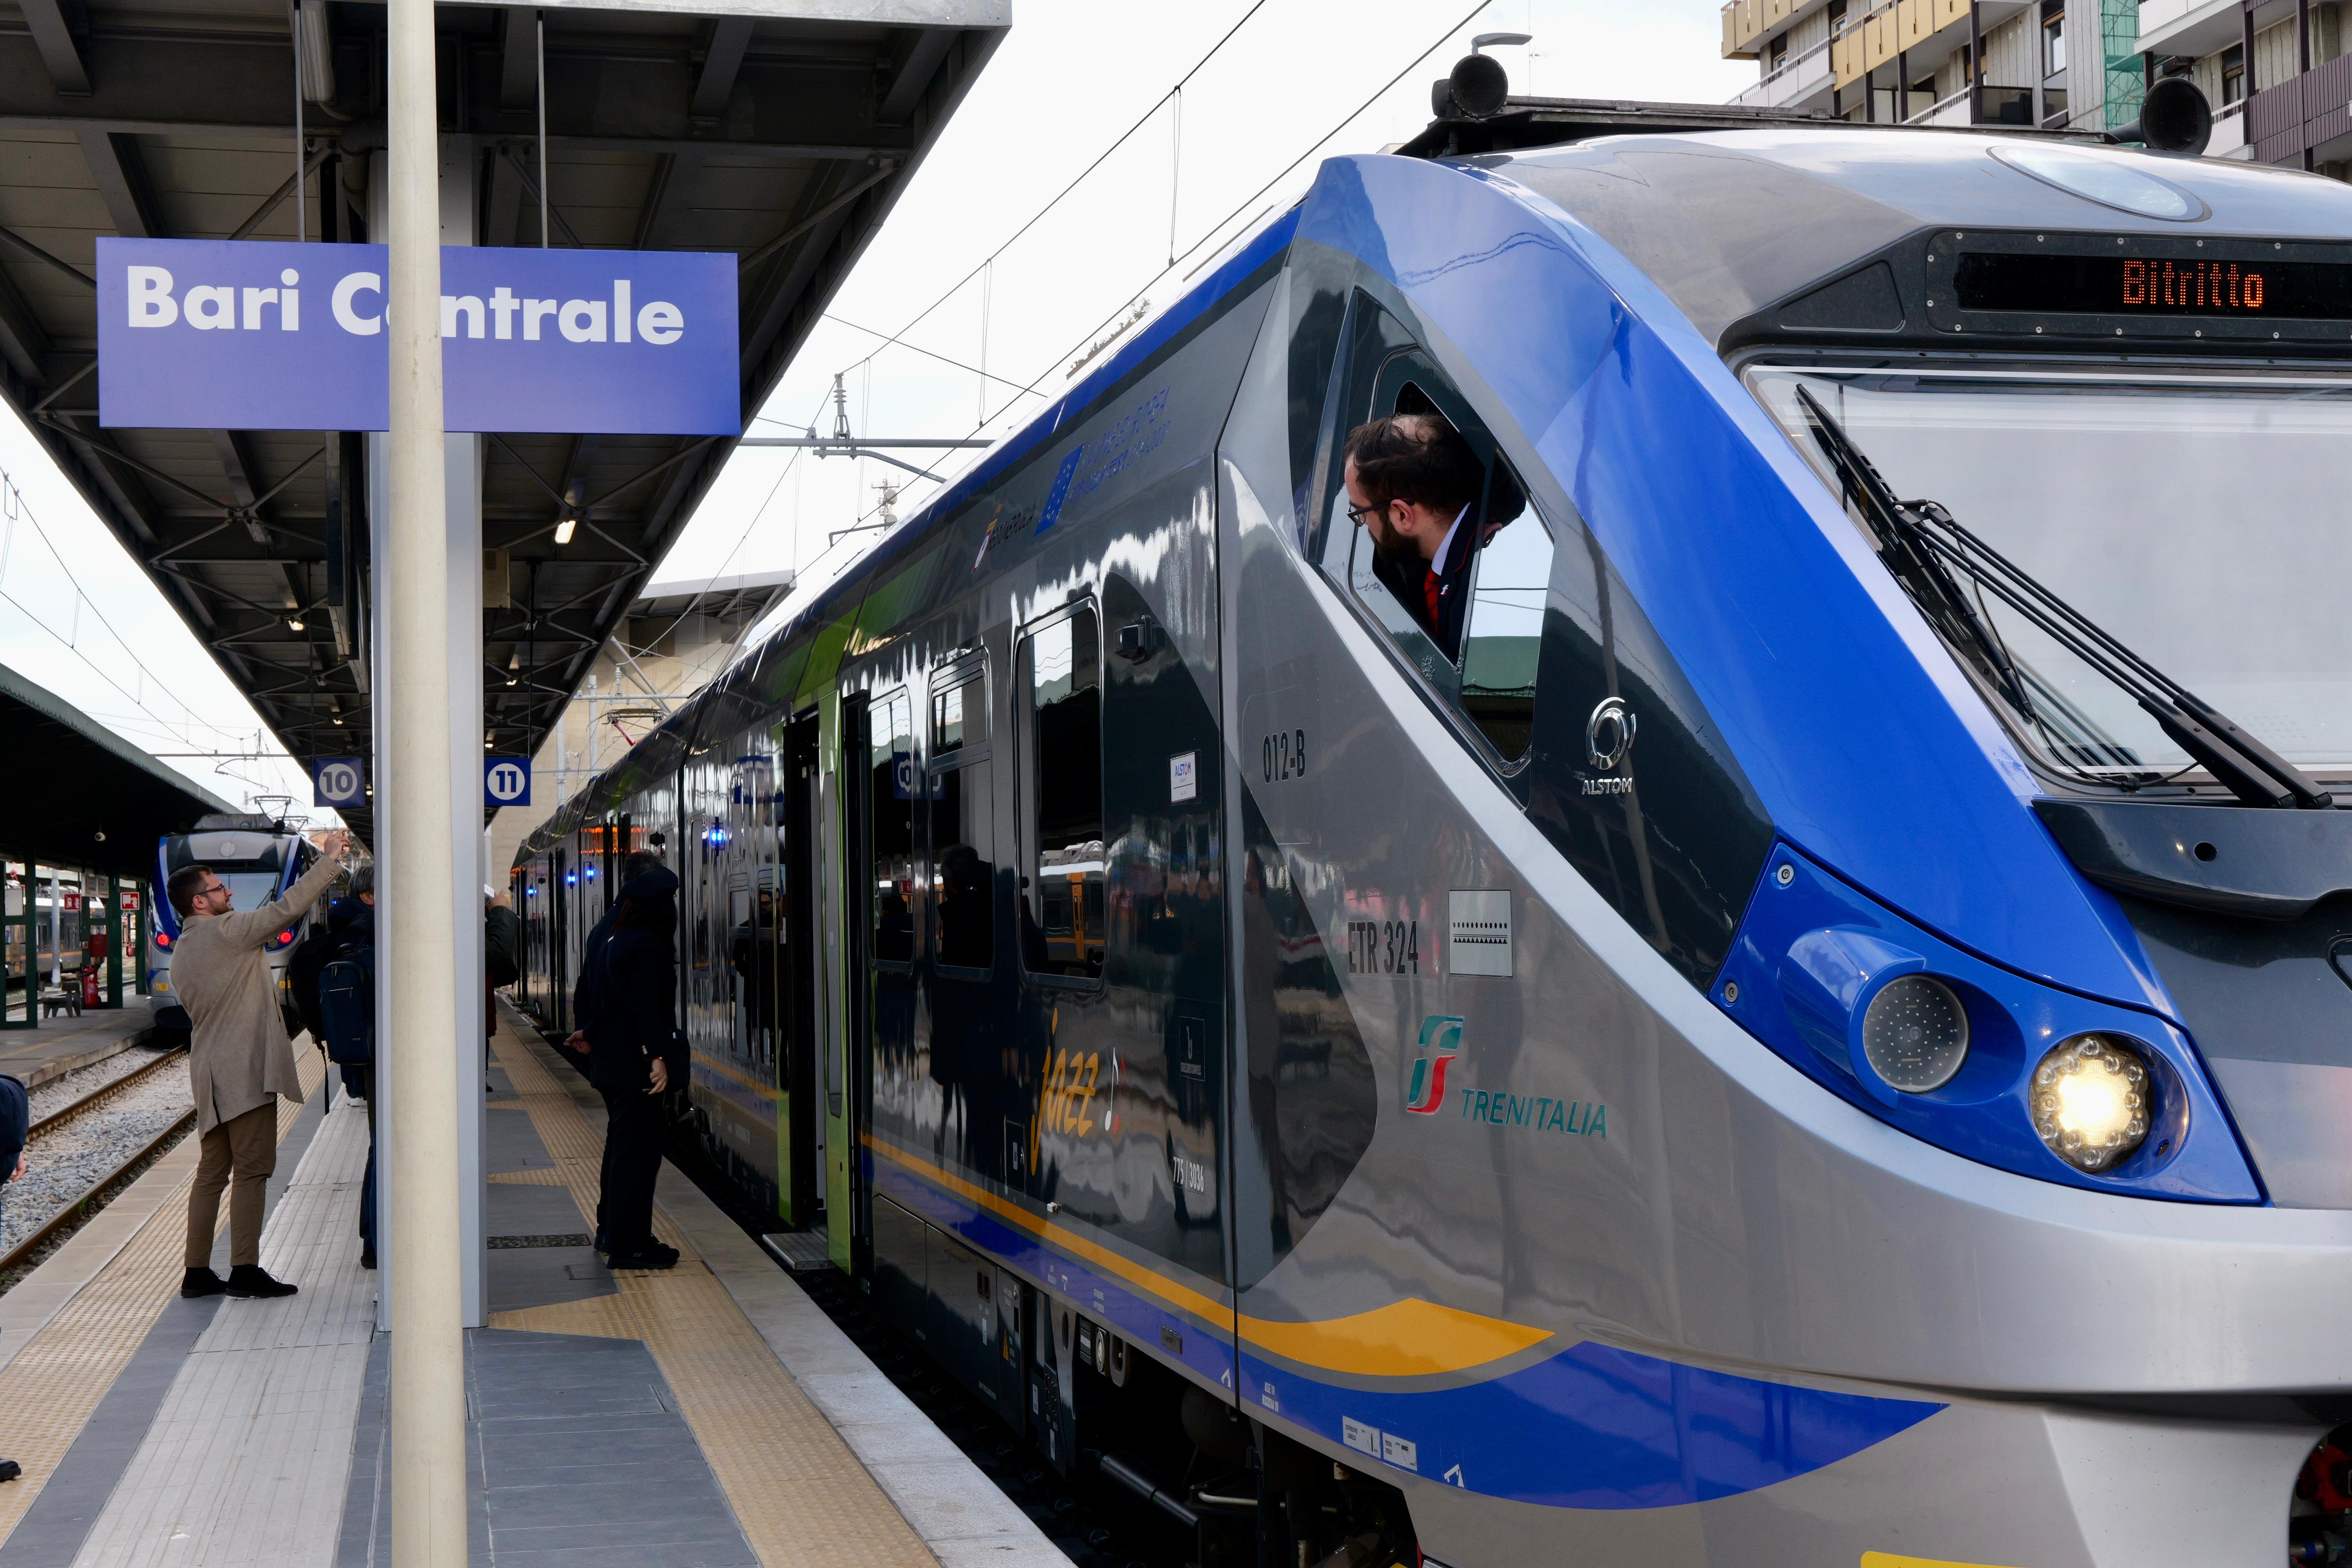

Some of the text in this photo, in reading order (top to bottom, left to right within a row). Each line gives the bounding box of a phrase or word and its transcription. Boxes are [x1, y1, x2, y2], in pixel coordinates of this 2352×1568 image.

[128, 265, 684, 345] Bari Cntrale
[2123, 260, 2265, 307] Bitritto
[1175, 761, 1191, 777] ALSTOM
[1262, 728, 1306, 784] 012-B
[322, 770, 352, 793] 10
[496, 770, 517, 793] 11
[1582, 777, 1633, 795] ALSTOM
[1348, 920, 1419, 975] ETR 324
[1030, 1007, 1099, 1176] jazz
[1460, 1089, 1607, 1140] TRENITALIA
[1173, 1156, 1184, 1185] 775
[1189, 1162, 1204, 1193] 3036
